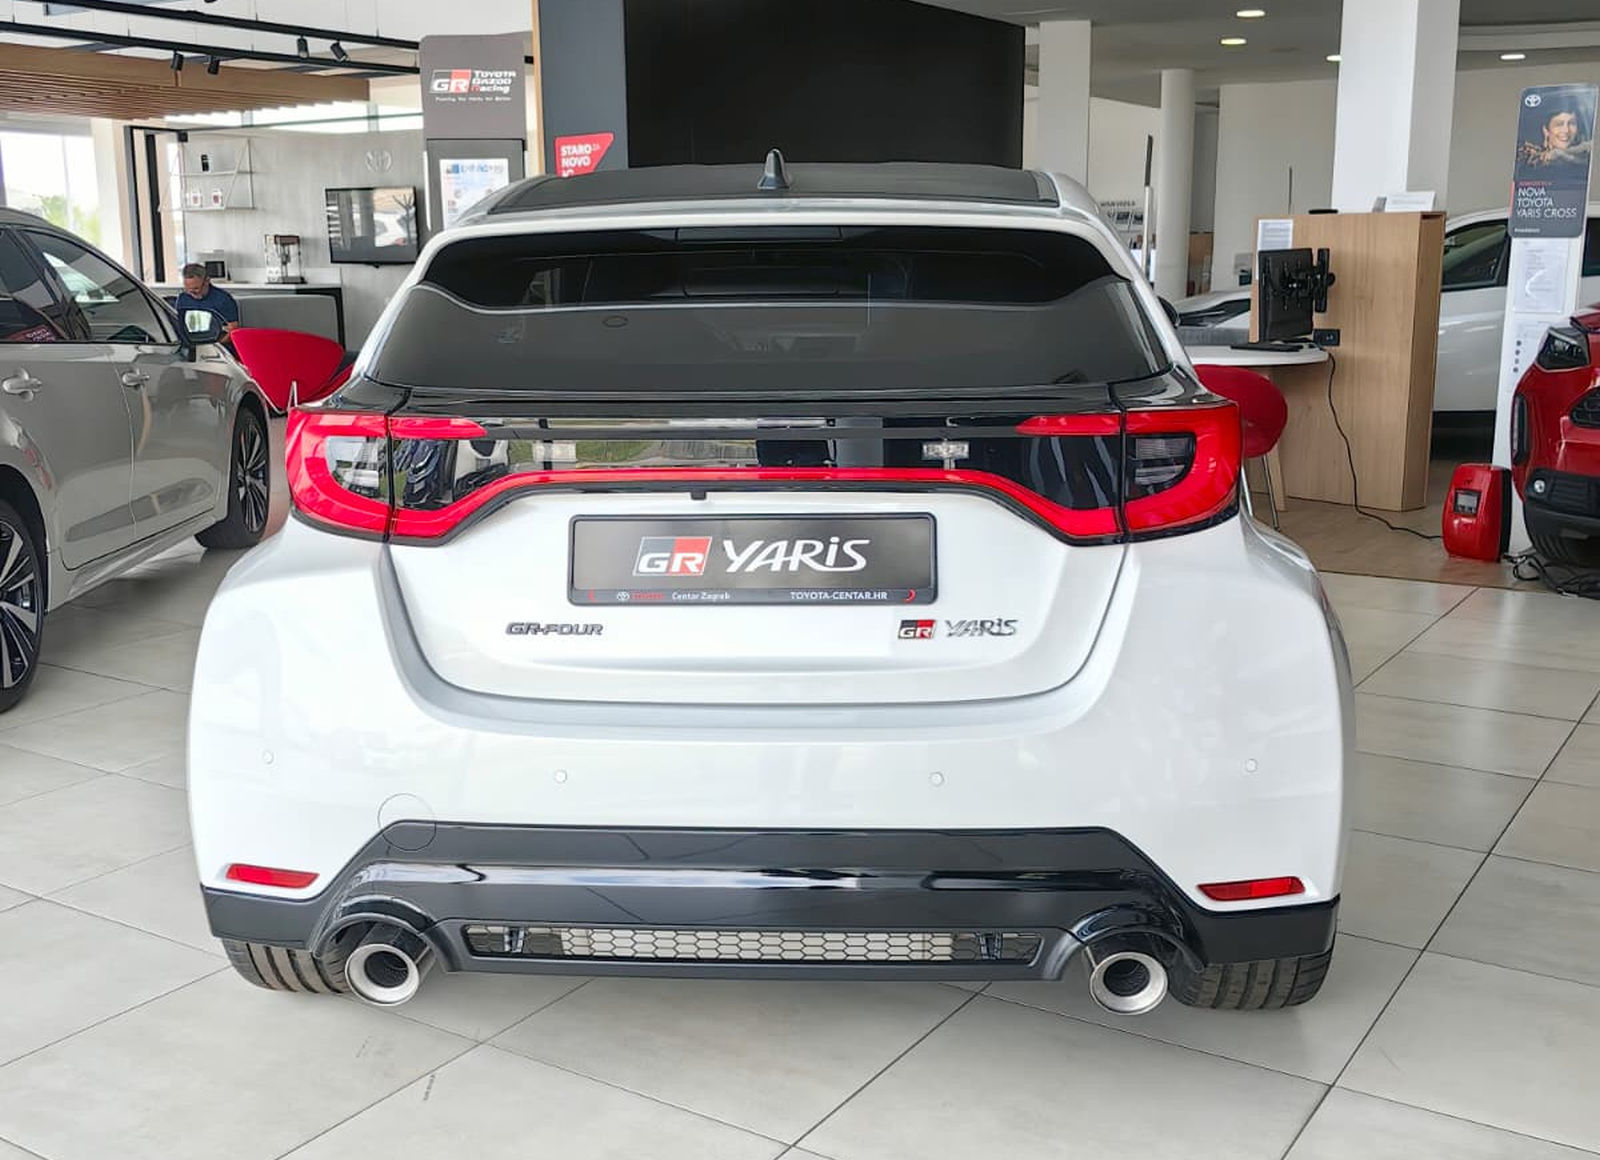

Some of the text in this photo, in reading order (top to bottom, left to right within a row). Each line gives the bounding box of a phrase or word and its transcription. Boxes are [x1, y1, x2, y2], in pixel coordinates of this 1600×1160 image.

[473, 70, 517, 78] TOYOTA
[432, 78, 468, 93] GR
[561, 144, 592, 156] STARO
[562, 156, 591, 168] NOVO
[1518, 187, 1546, 197] NOVA
[1517, 198, 1554, 208] TOYOTA
[1517, 208, 1577, 218] YARIS CROSS
[638, 552, 705, 573] GR
[672, 591, 699, 600] Centar
[790, 591, 888, 600] TOYOTA-CENTAR.HR
[505, 622, 604, 635] GR-FOUR
